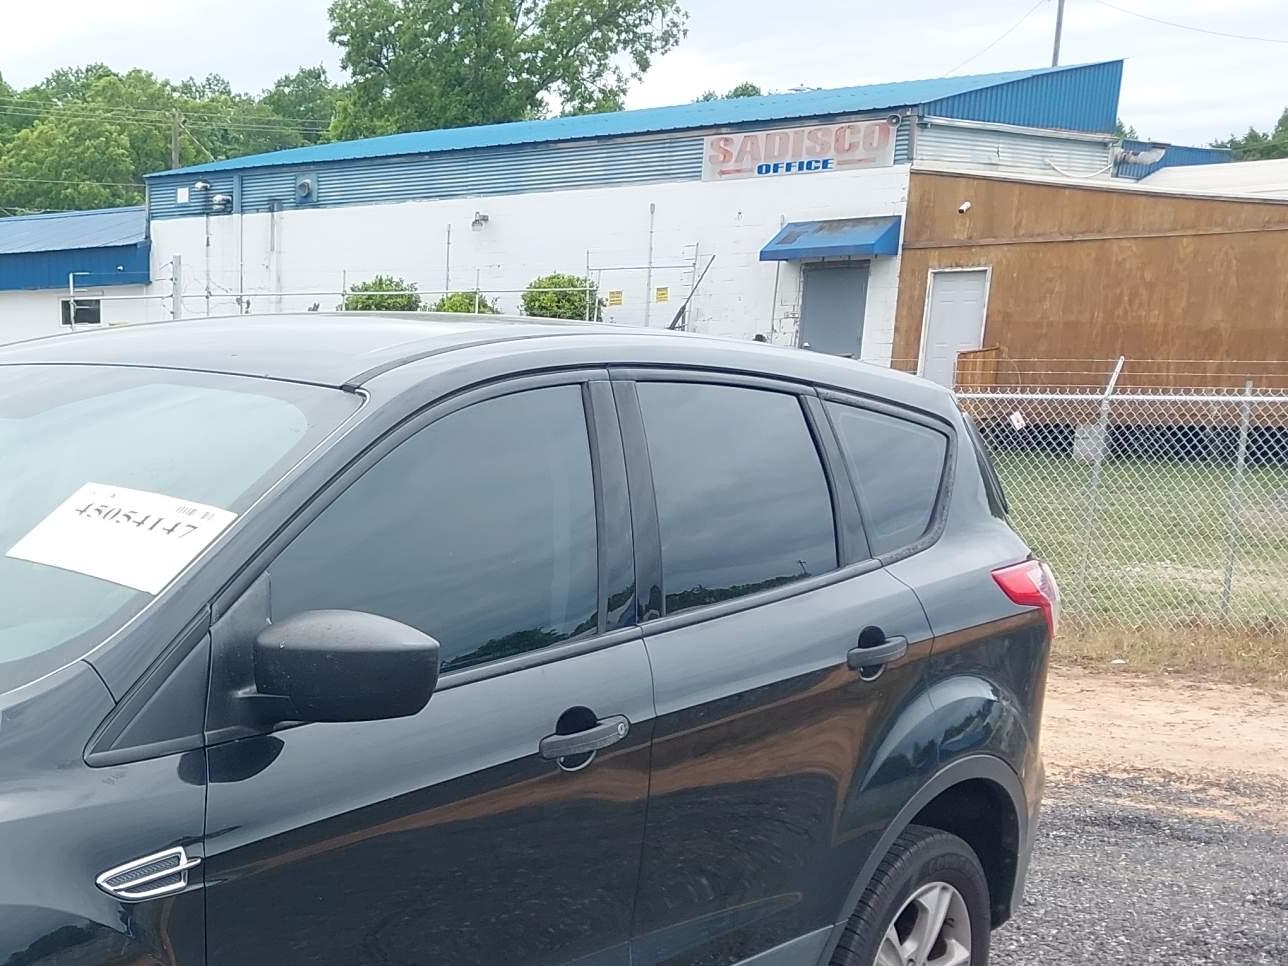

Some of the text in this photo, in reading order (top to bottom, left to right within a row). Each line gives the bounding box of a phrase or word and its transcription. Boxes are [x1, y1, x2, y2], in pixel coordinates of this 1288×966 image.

[709, 123, 890, 164] SADISCO
[756, 158, 835, 176] OFFICE
[75, 502, 199, 538] 45054147
